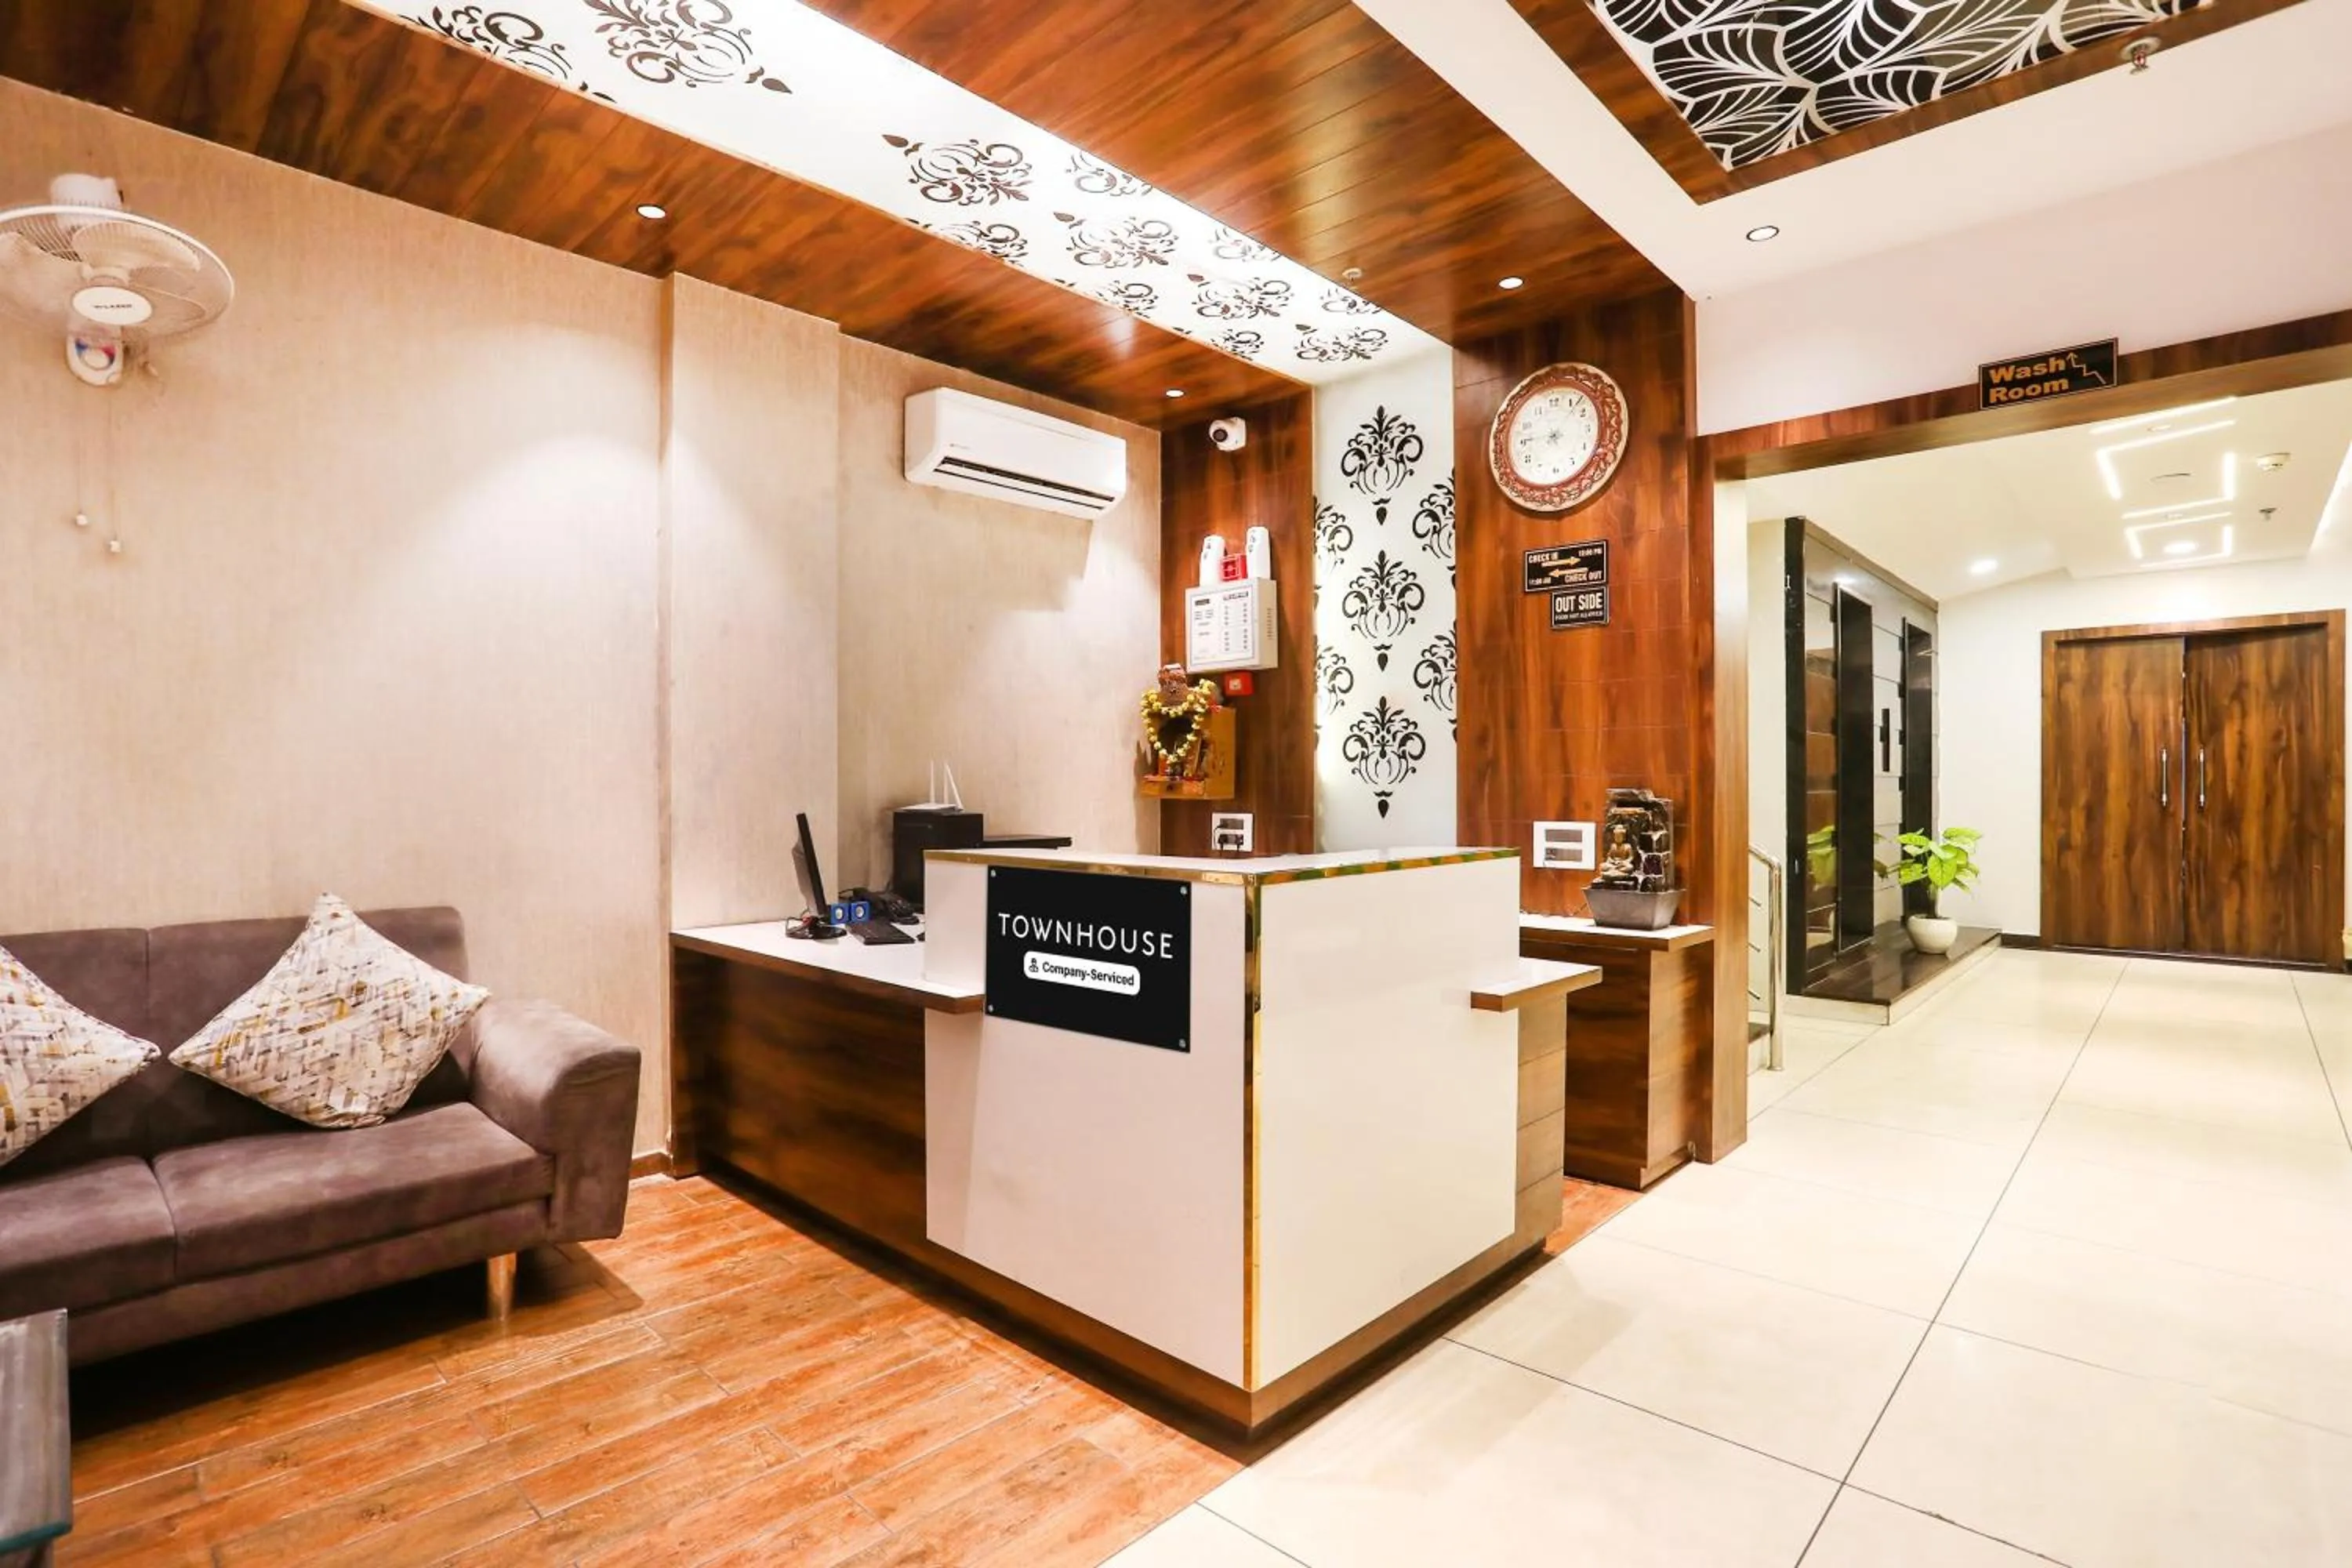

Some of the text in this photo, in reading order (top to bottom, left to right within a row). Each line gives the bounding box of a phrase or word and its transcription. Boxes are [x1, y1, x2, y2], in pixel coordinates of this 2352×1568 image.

[1989, 357, 2067, 383] Wash
[1989, 378, 2069, 403] Room
[1528, 554, 1549, 564] CHECK
[1564, 571, 1602, 583] CHECK OUT
[1555, 593, 1603, 612] OUT SIDE
[998, 912, 1174, 960] TOWNHOUSE
[1042, 961, 1135, 987] Company-Serviced
